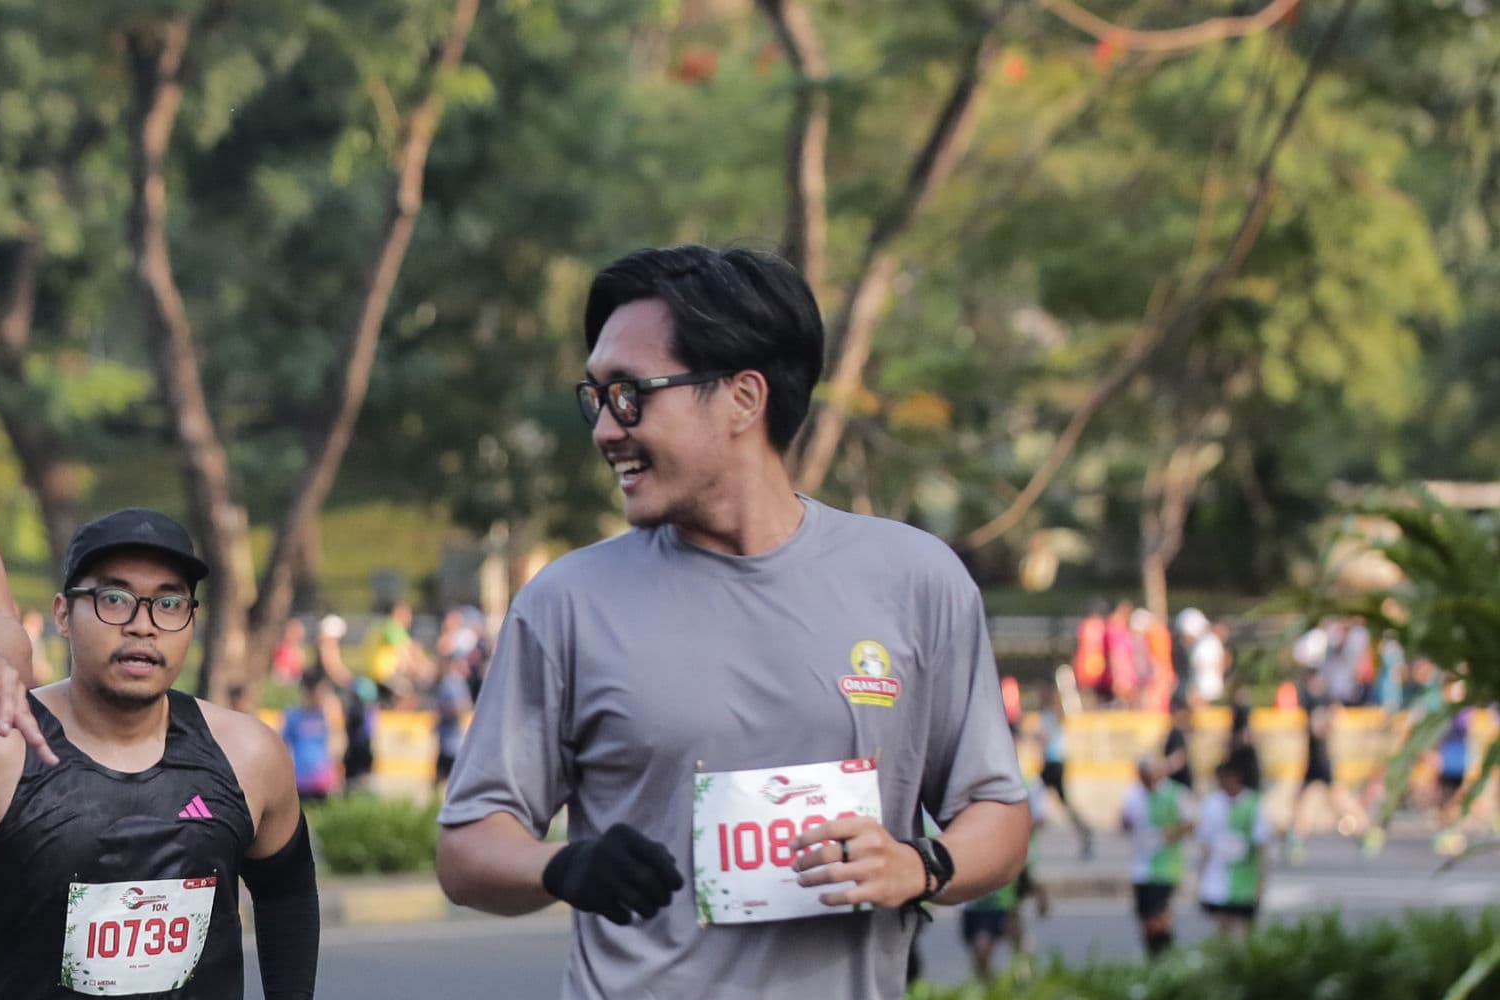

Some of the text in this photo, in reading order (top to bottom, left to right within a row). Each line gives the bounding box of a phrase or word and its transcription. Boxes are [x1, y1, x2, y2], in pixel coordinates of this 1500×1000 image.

[717, 811, 859, 873] 108
[152, 903, 169, 912] 10K
[86, 916, 191, 959] 10739
